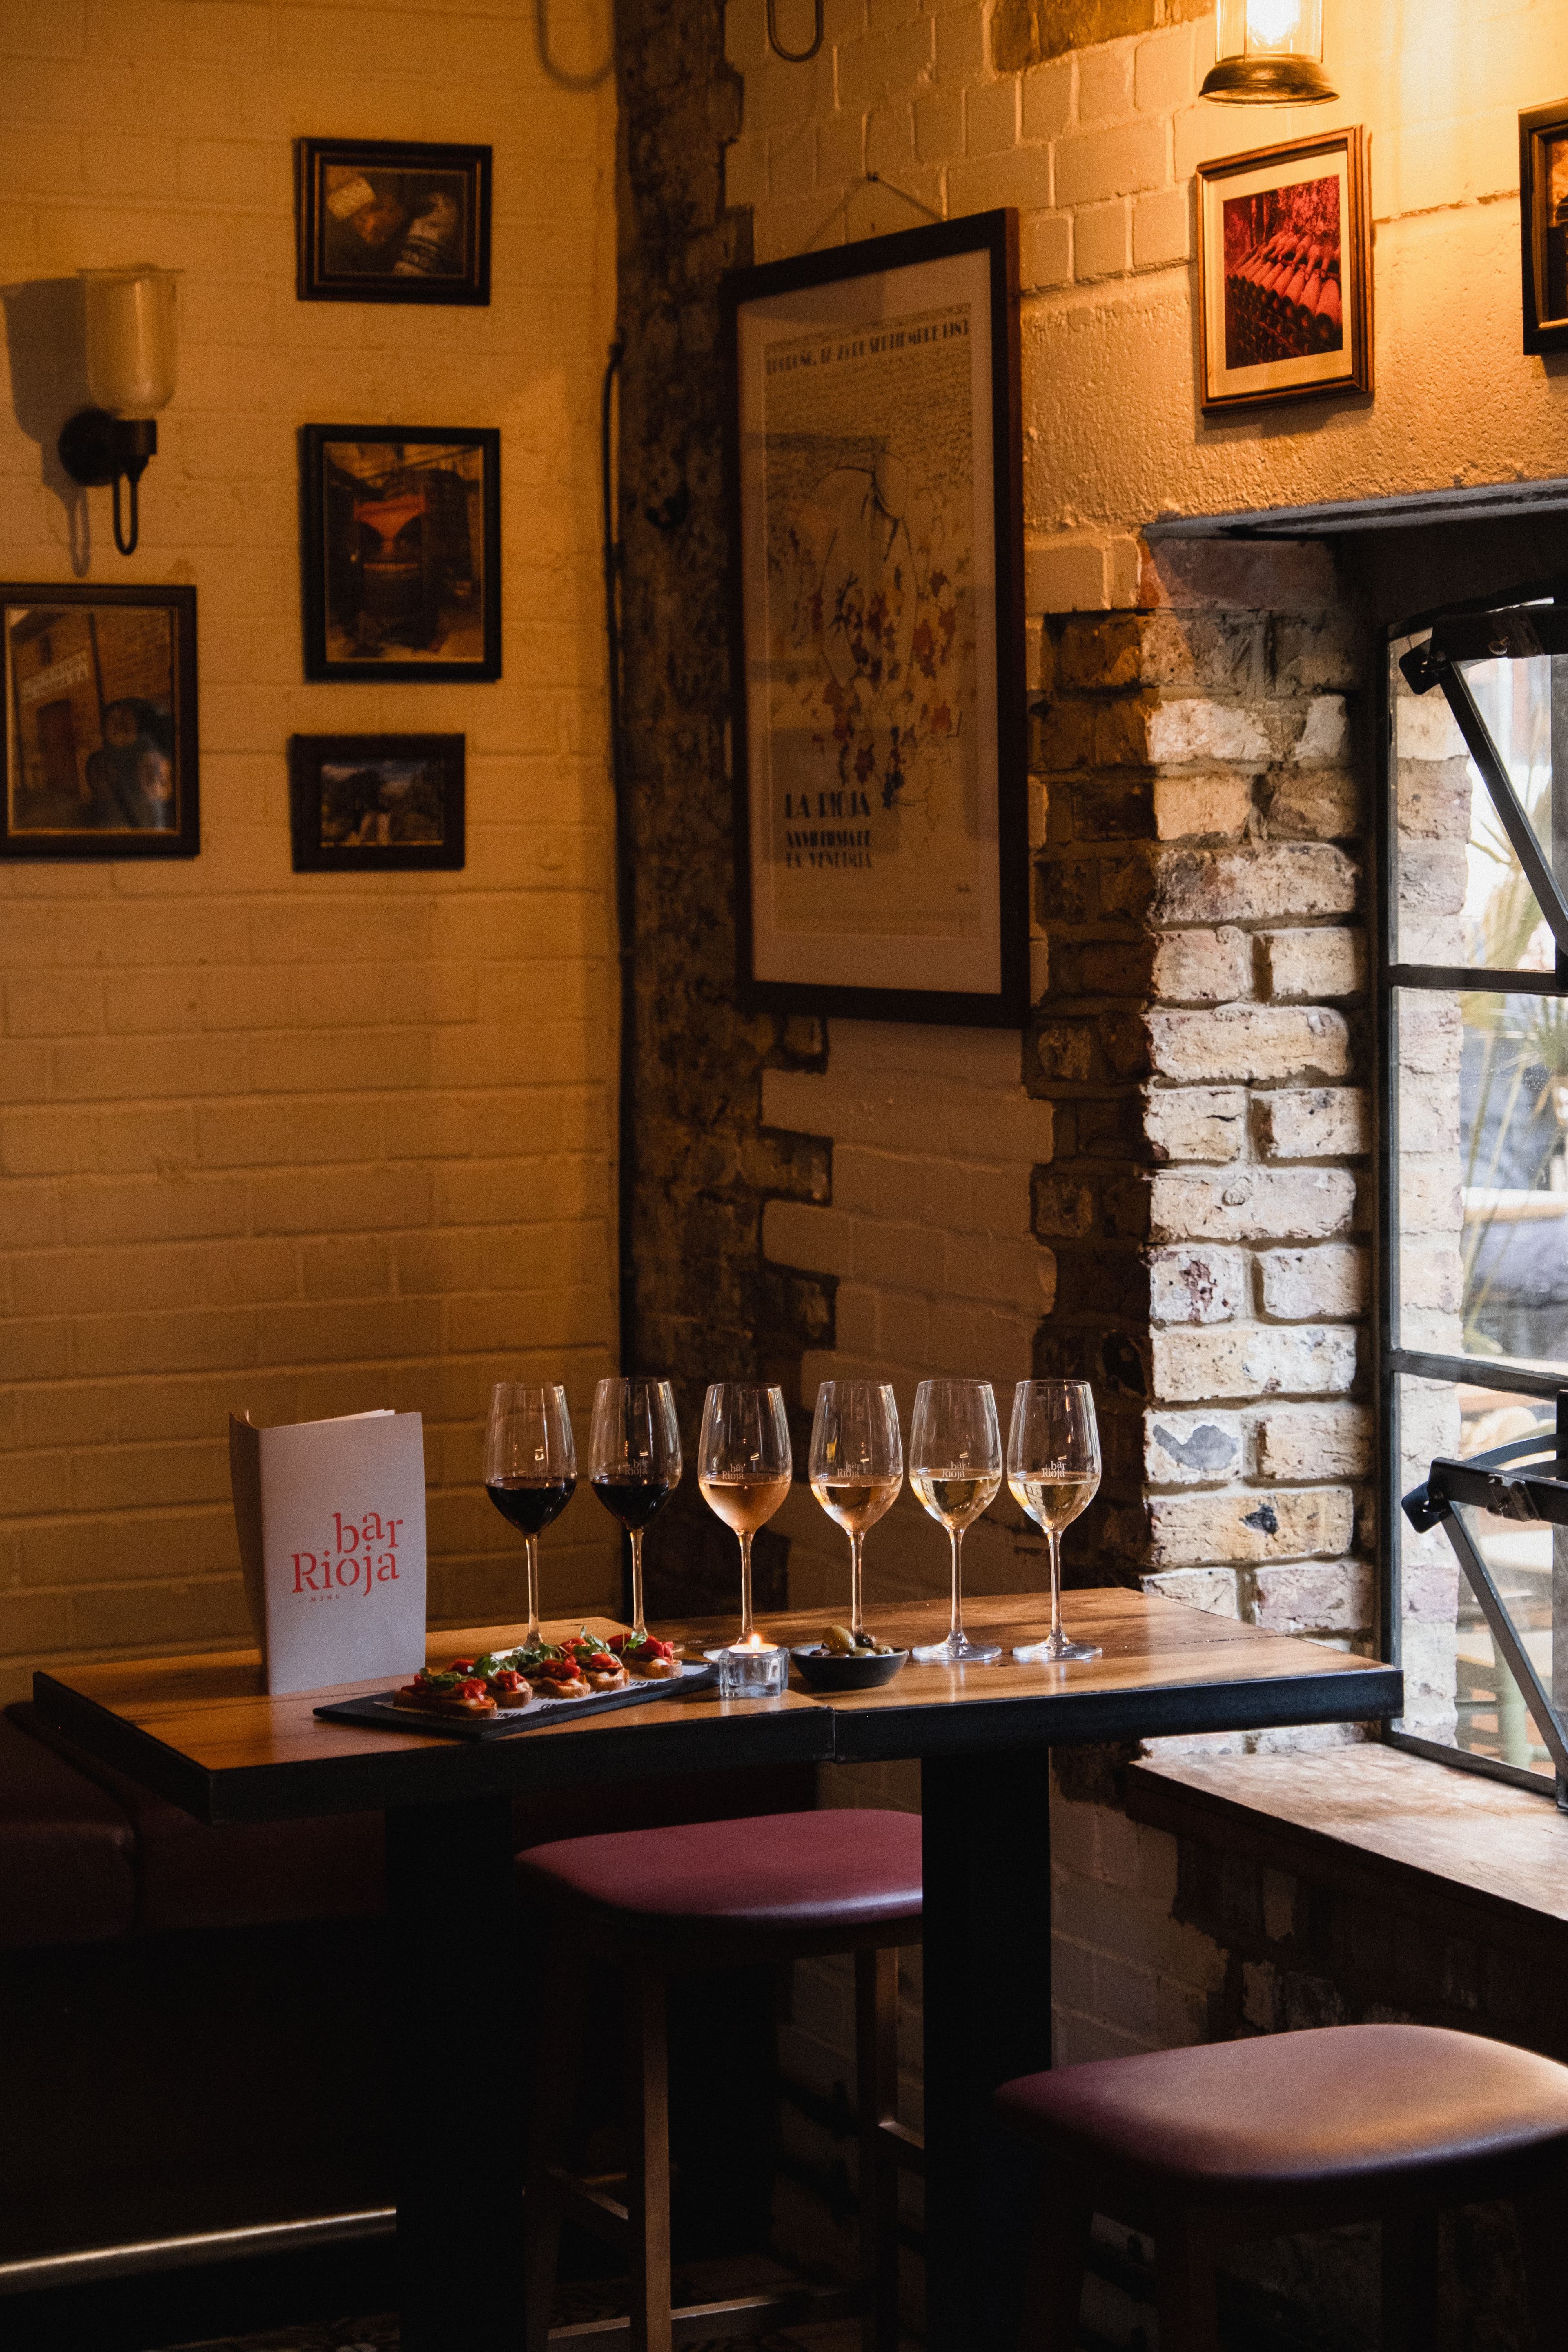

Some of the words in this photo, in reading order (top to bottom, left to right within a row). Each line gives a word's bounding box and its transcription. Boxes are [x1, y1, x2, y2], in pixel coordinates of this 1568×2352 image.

[730, 1463, 746, 1472] bar
[846, 1461, 861, 1471] bar
[951, 1461, 965, 1471] bar
[1051, 1461, 1066, 1470] bar
[625, 1466, 647, 1476] Rioja
[722, 1470, 744, 1482] Rioja
[837, 1468, 860, 1479] Rioja
[942, 1468, 965, 1480] Rioja
[1042, 1468, 1065, 1479] Rioja
[332, 1512, 403, 1555] bar
[291, 1545, 400, 1597] Rioja
[310, 1593, 341, 1603] MENU
